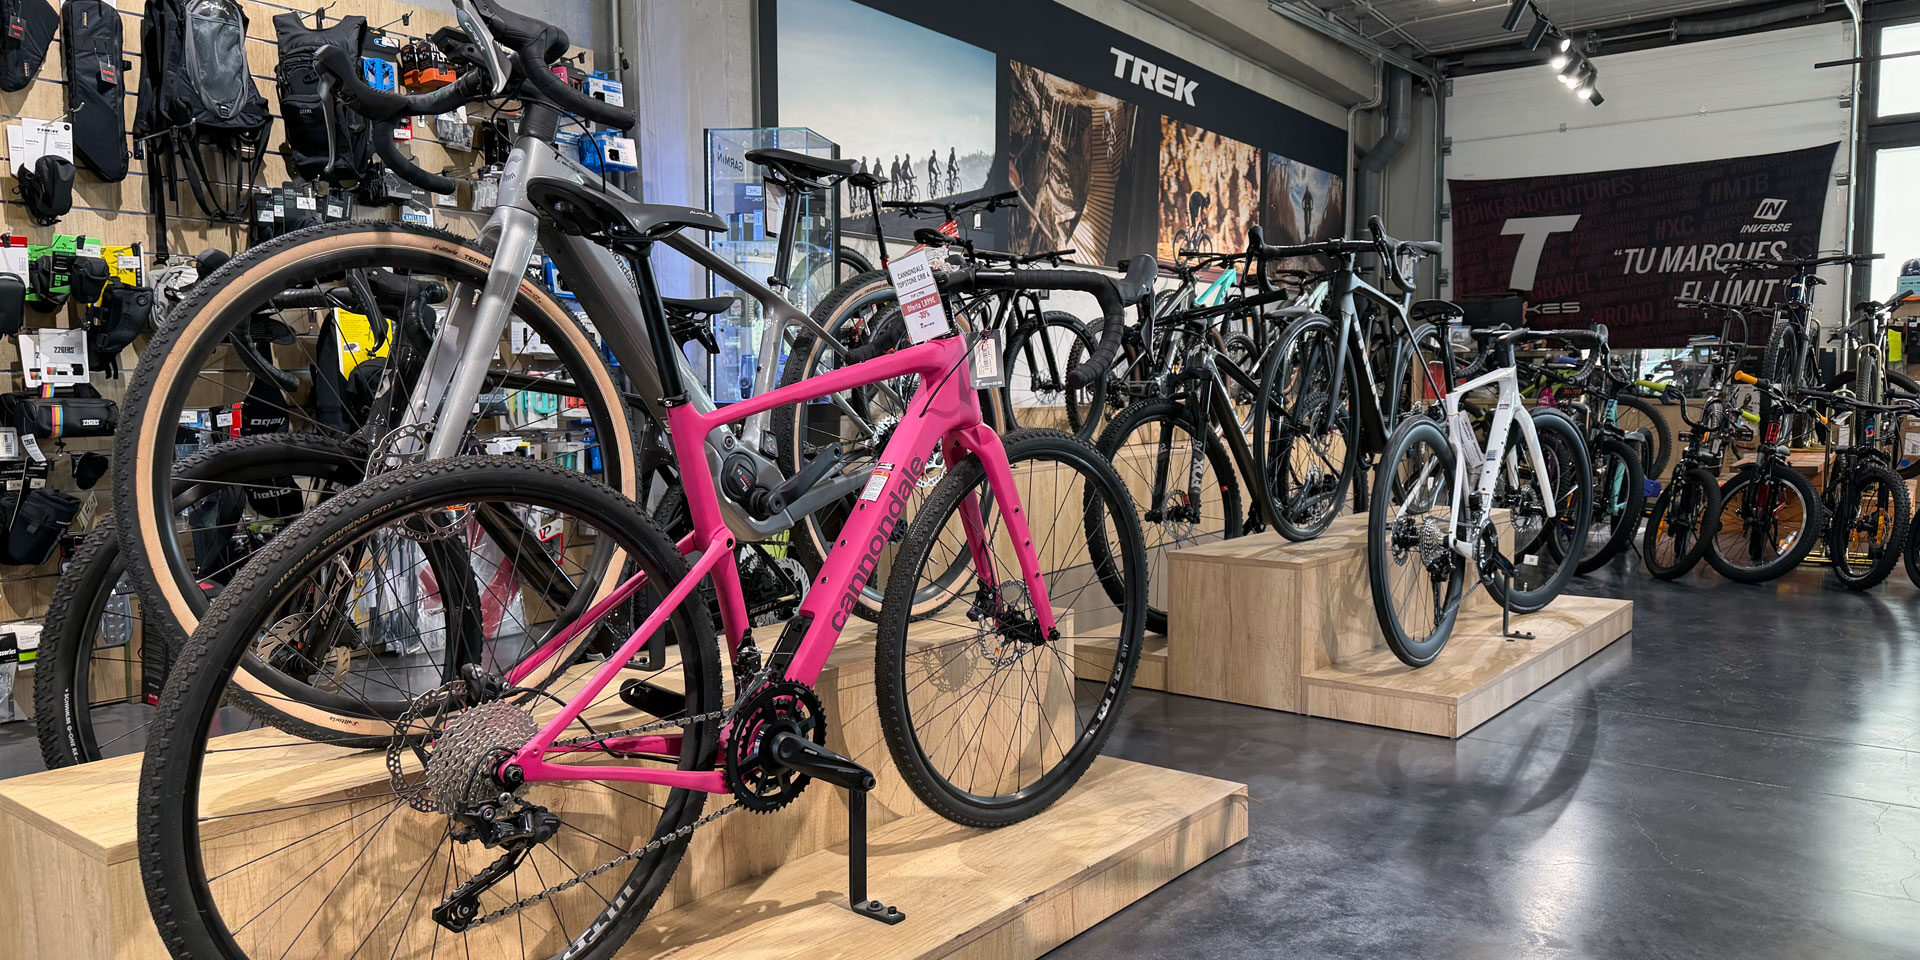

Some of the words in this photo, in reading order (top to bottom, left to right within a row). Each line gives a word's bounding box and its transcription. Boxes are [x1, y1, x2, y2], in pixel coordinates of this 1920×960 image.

[1110, 46, 1199, 107] TREK
[1709, 173, 1769, 204] #MTB
[1655, 215, 1695, 241] #XC
[1740, 223, 1793, 234] INVERSE
[1500, 213, 1582, 291] T
[1657, 240, 1788, 274] MARQUES
[897, 263, 925, 280] CANNONDALE
[53, 346, 75, 354] 226ERS
[1190, 458, 1204, 488] FOX
[322, 514, 370, 546] TERRENO
[372, 501, 394, 516] DRY
[831, 456, 924, 632] cannondale
